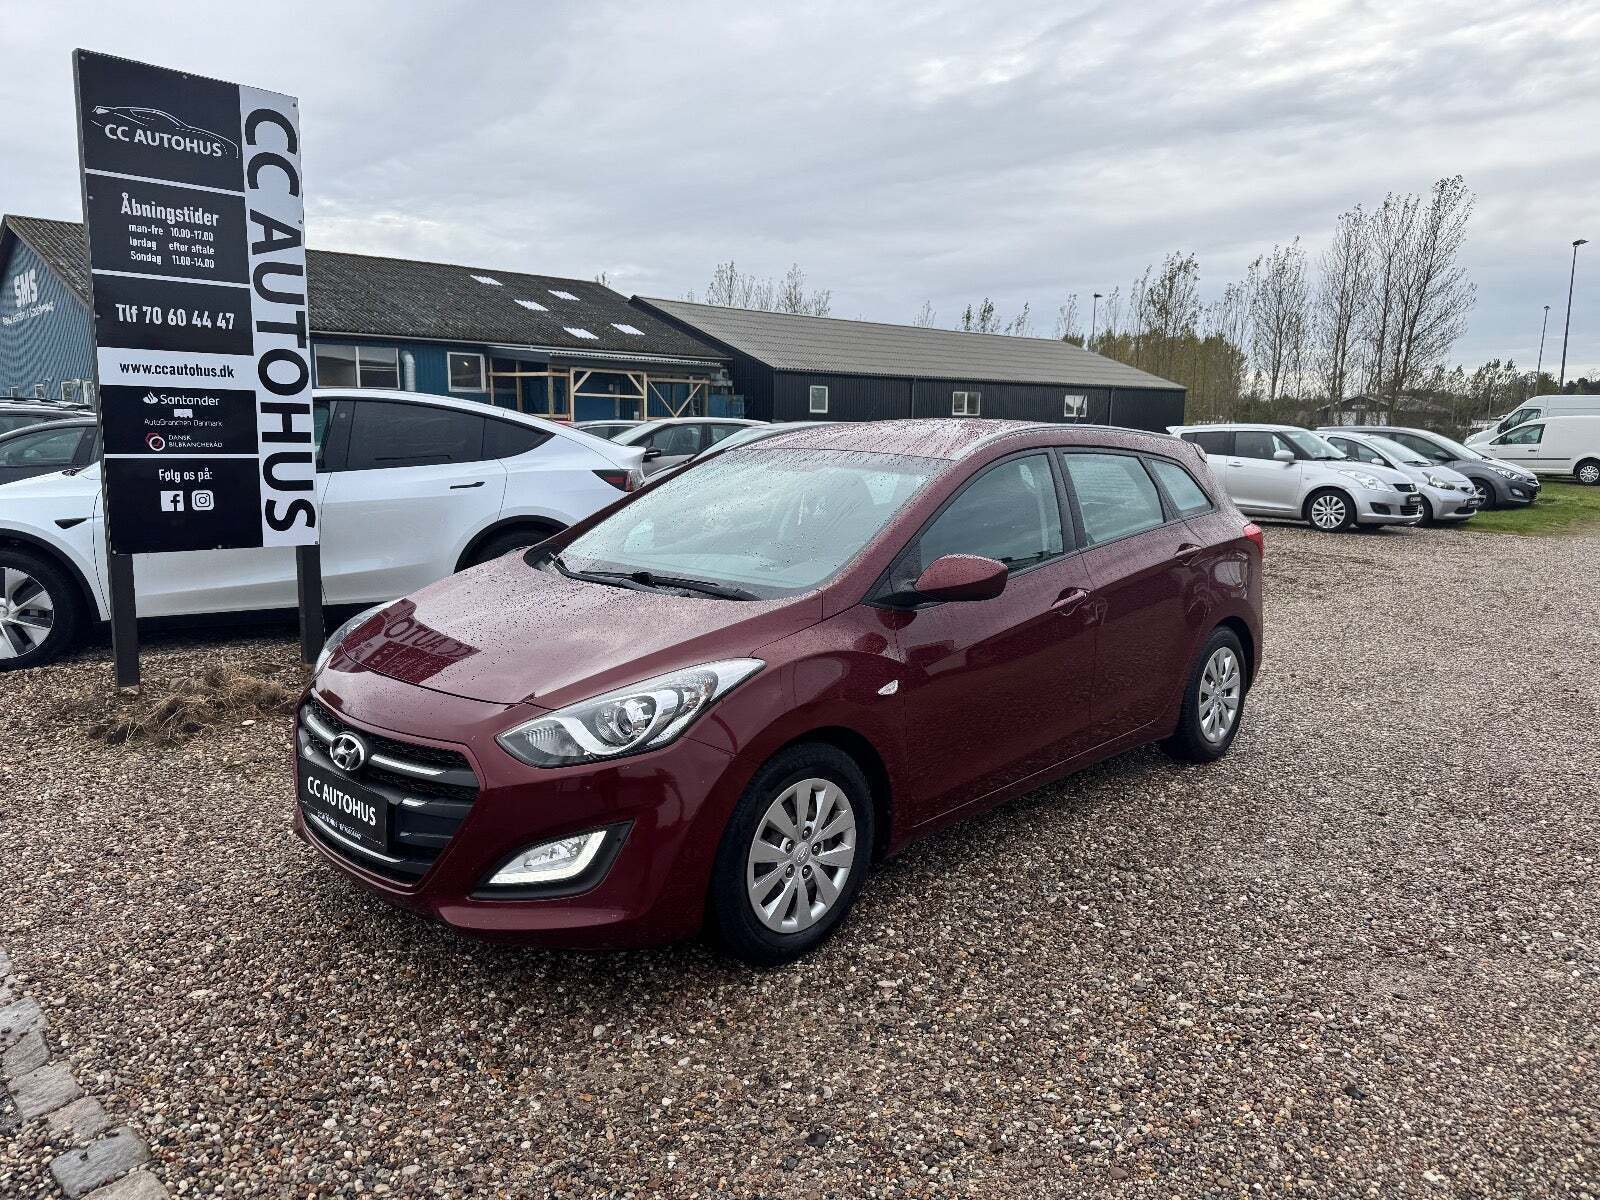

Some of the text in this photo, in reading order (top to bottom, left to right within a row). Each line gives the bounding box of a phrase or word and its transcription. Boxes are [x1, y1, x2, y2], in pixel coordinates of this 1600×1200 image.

[104, 123, 222, 157] CC AUTOHUS
[120, 192, 219, 227] Åbningstider
[128, 224, 214, 242] man-fre 10.00-17.00
[168, 241, 189, 253] efter
[191, 244, 215, 255] aftale
[172, 255, 215, 269] 11.00-14.00
[115, 303, 235, 330] Tlf 70 60 44 47
[244, 108, 316, 532] CC AUTOHUS
[119, 362, 235, 379] www.ccautohus.dk
[160, 394, 220, 406] Santander
[158, 467, 213, 484] Følg os på:
[307, 776, 321, 798] CC
[322, 783, 377, 826] AUTOHUS
